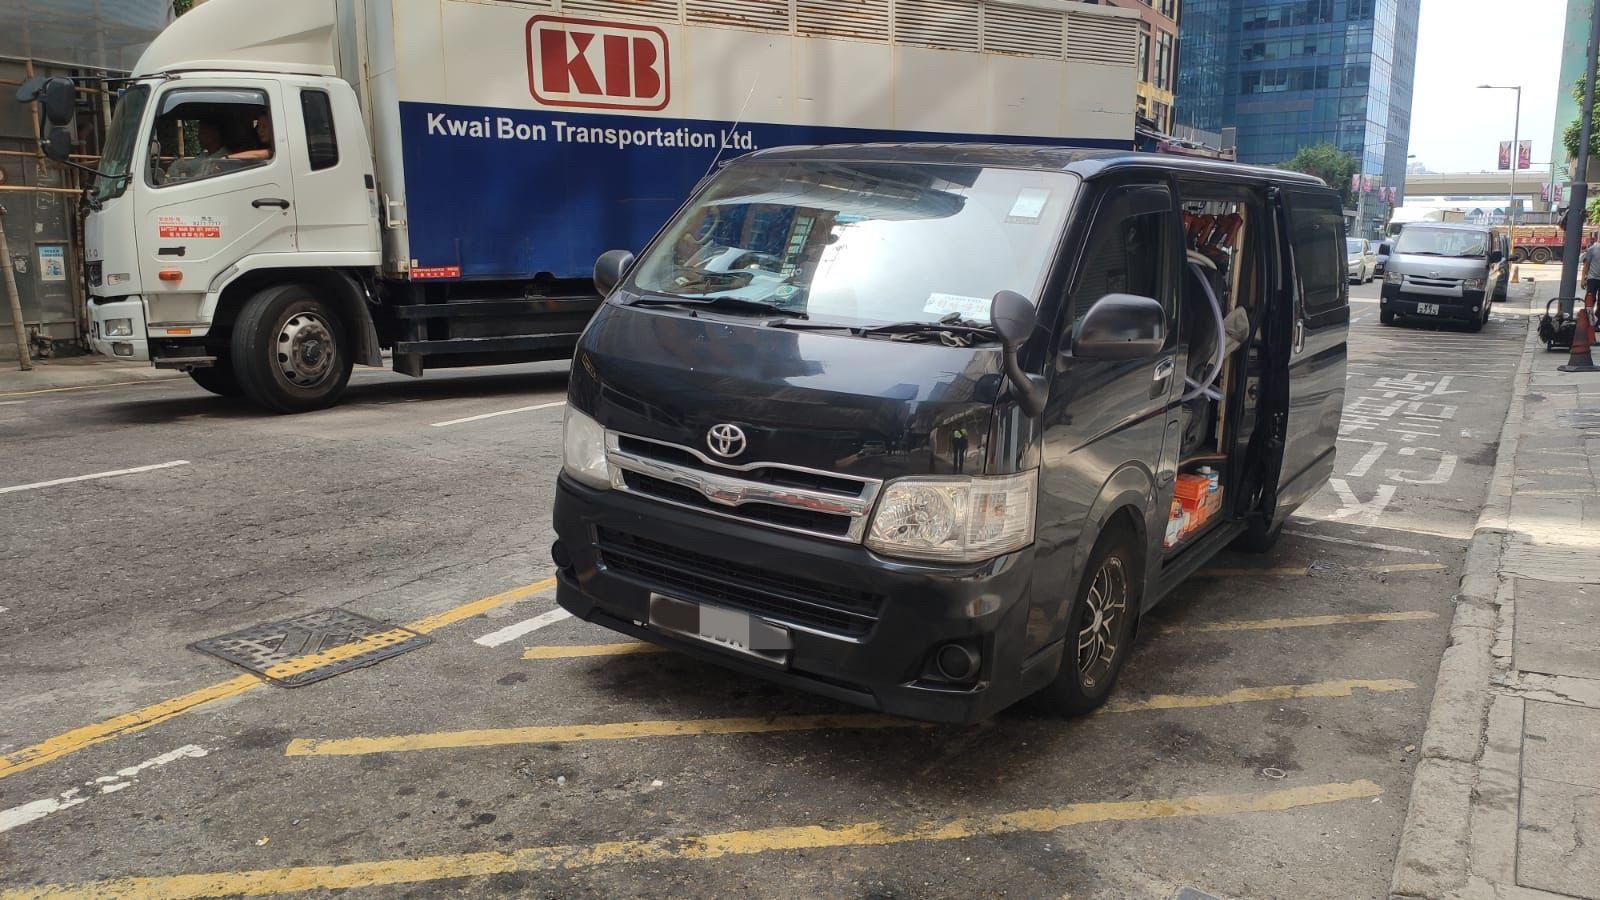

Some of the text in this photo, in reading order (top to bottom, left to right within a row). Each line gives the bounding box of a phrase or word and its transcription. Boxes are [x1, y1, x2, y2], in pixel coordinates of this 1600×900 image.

[427, 112, 758, 150] Kwai Bon Transportation Ltd.
